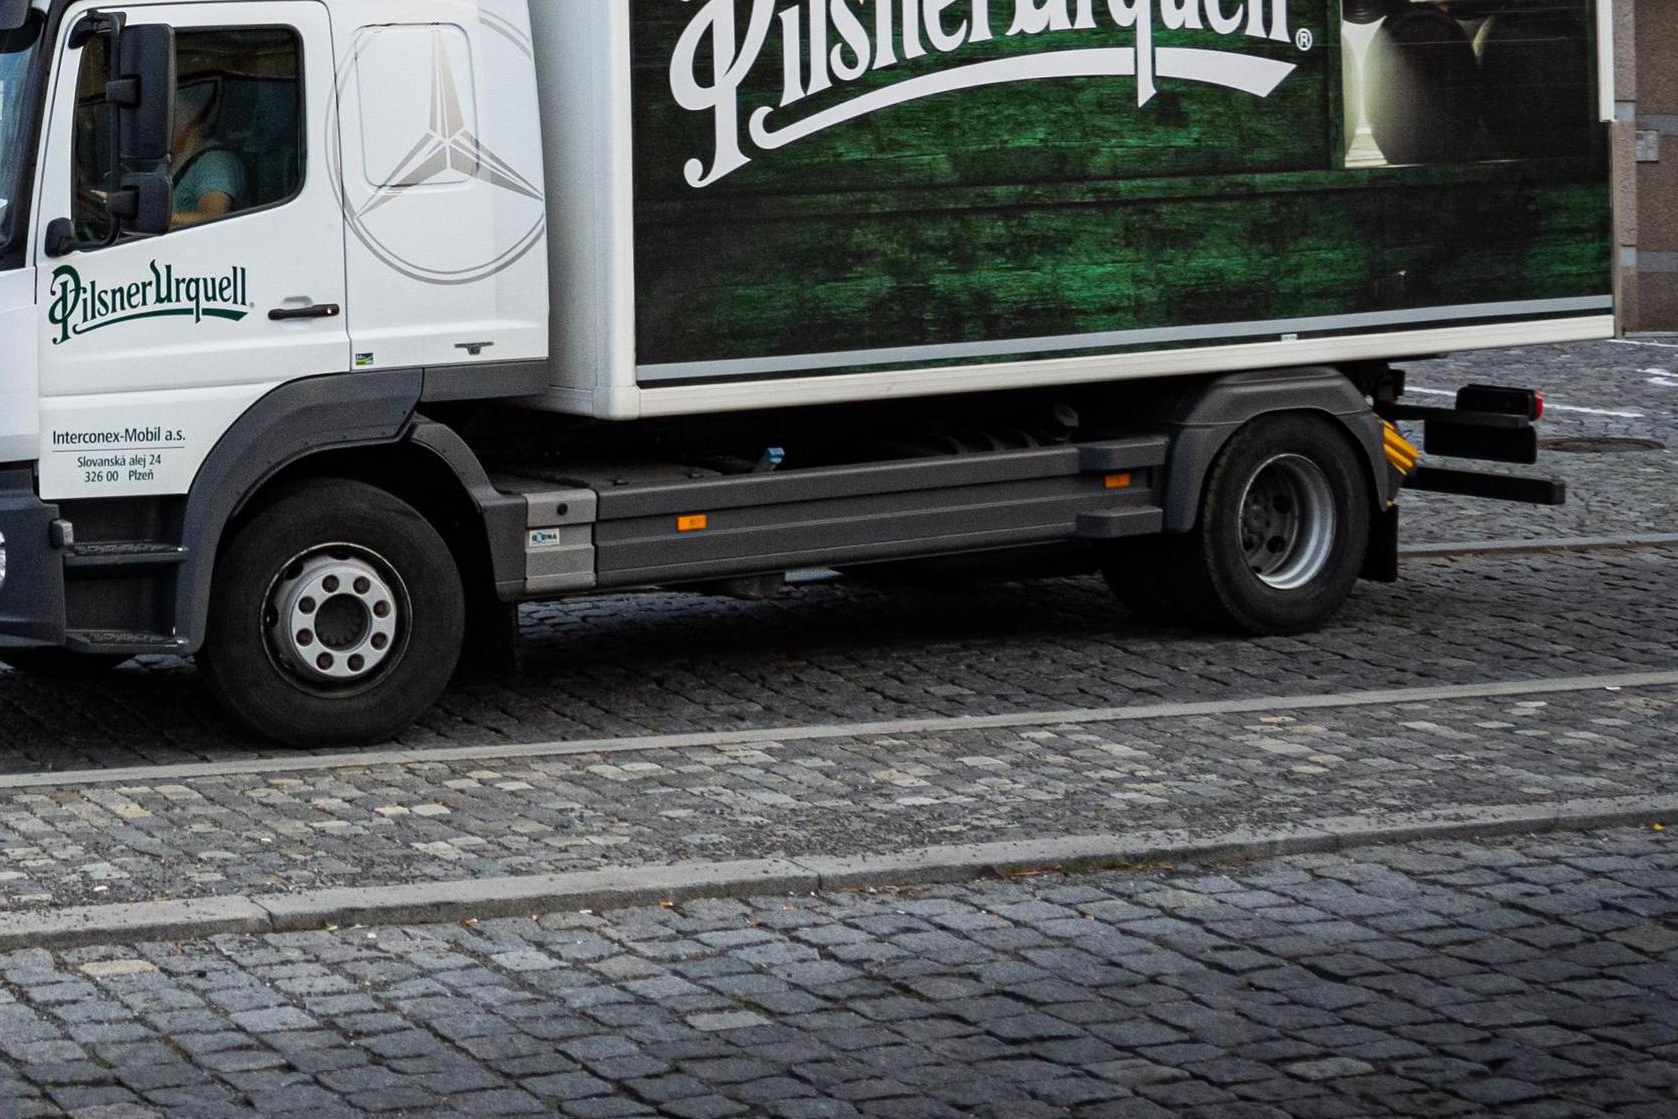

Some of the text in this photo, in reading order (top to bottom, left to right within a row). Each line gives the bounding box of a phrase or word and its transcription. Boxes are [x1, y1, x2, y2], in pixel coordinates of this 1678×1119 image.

[48, 264, 153, 345] Pilsner
[53, 426, 186, 444] Interconex-Mobil a.s.
[77, 454, 161, 468] Slovanská alej 24
[85, 469, 154, 483] 326 00 Plzeň
